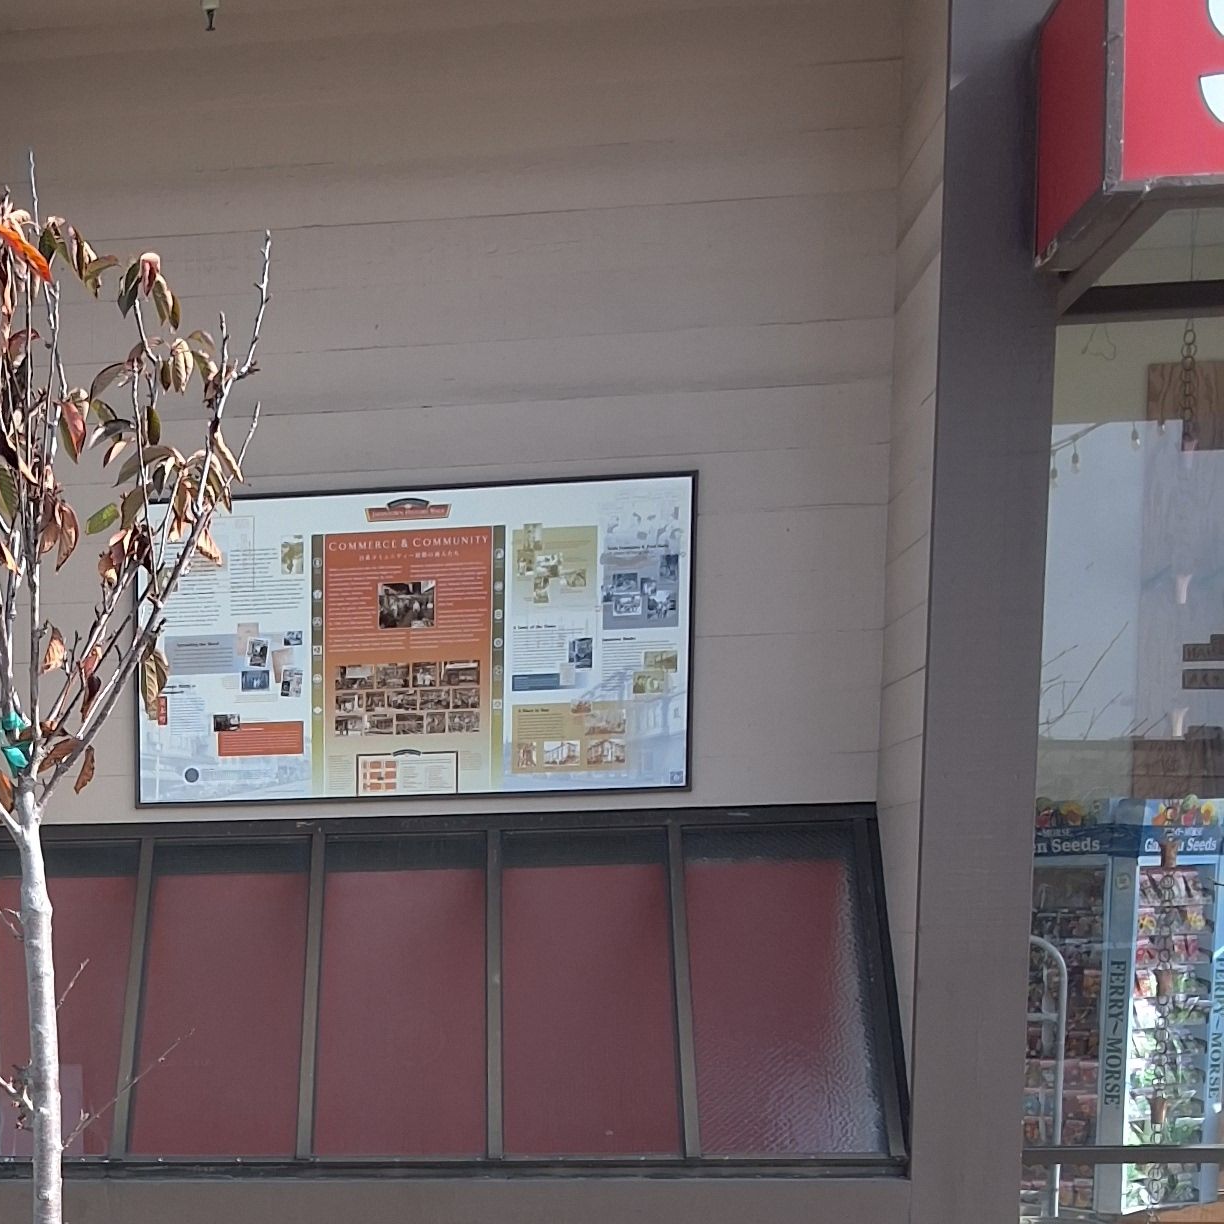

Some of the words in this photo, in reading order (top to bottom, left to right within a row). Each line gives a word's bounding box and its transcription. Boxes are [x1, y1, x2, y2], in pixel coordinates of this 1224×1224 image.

[328, 539, 398, 552] COMMERCE
[400, 538, 408, 548] &
[412, 535, 489, 548] COMMUNITY
[1051, 838, 1100, 852] Seeds
[1187, 837, 1217, 851] Seeds
